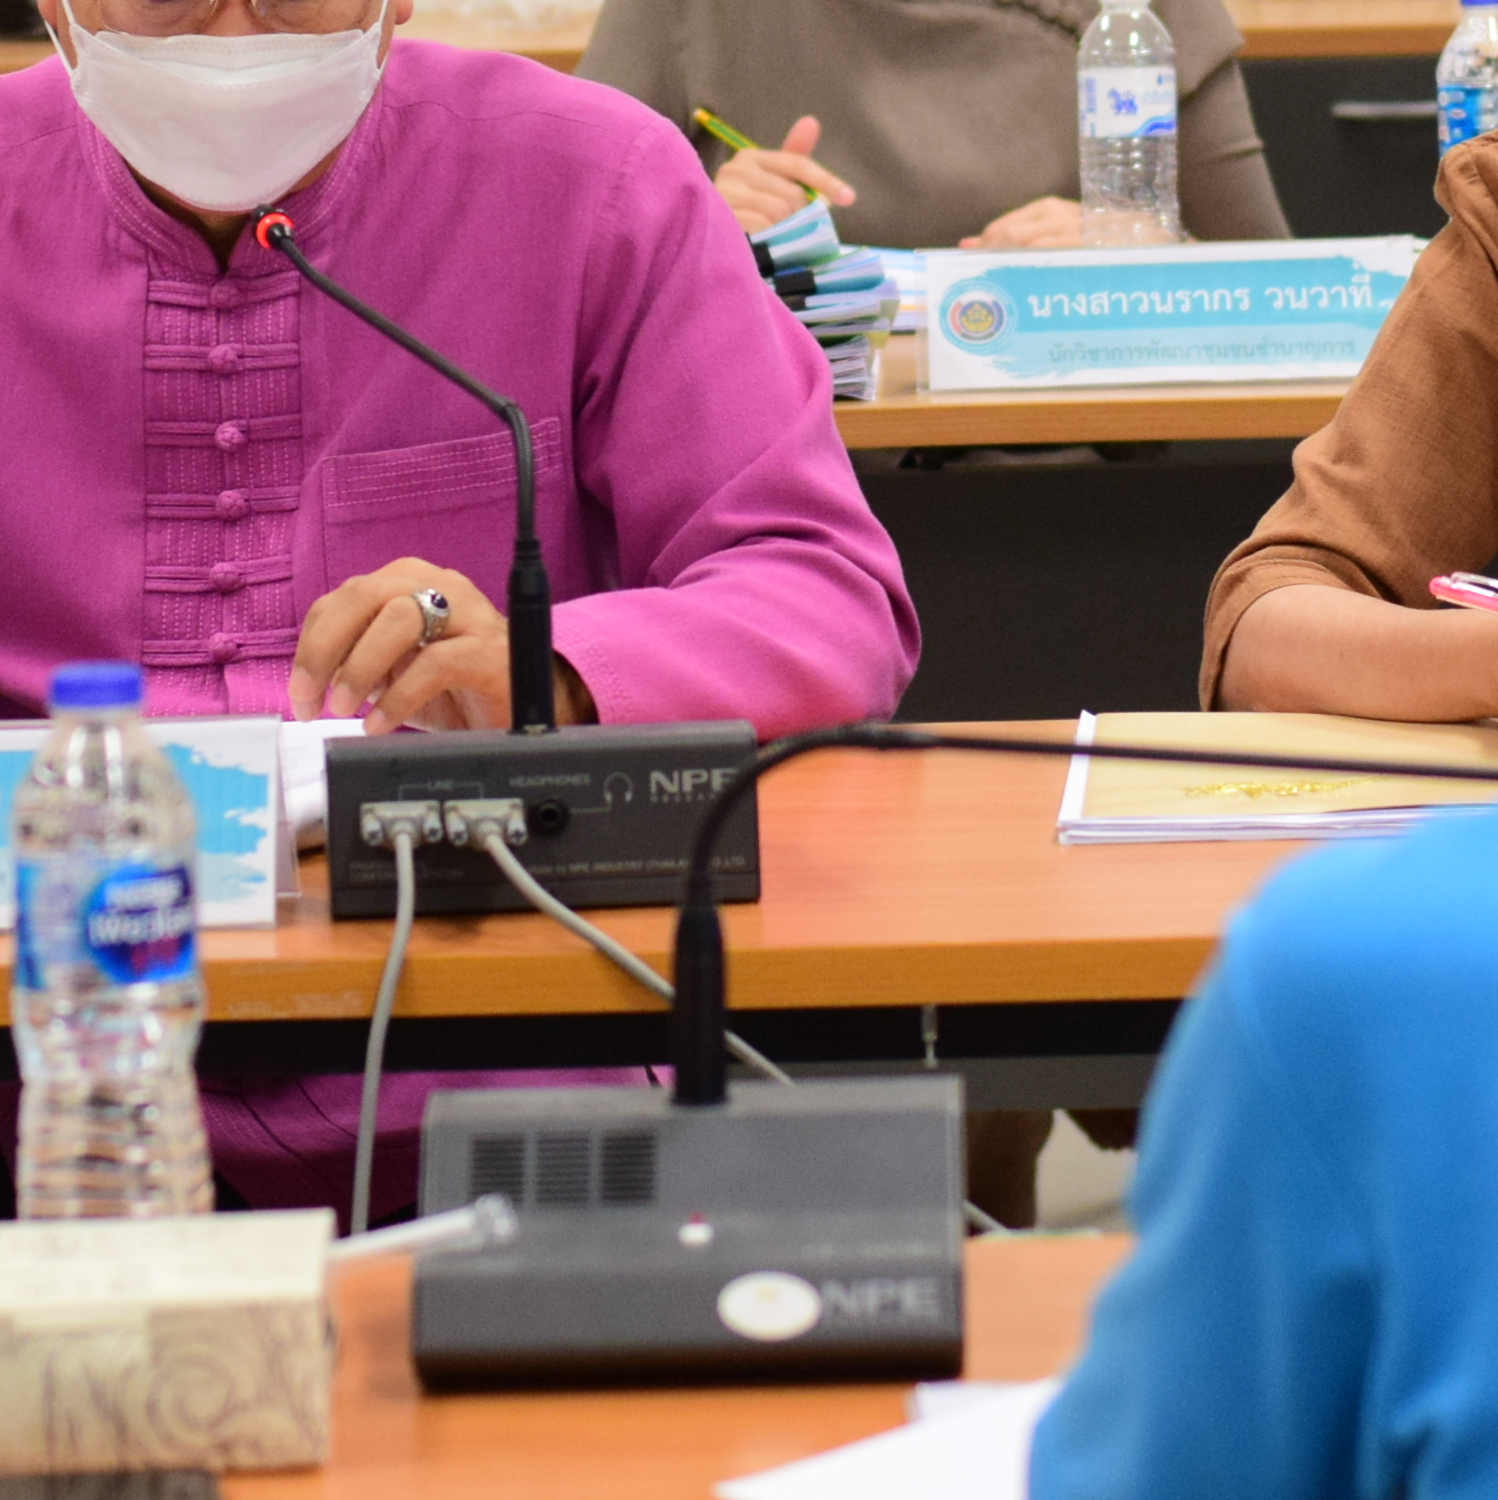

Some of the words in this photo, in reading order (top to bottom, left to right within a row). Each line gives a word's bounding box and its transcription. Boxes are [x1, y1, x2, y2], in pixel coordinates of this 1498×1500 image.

[1027, 285, 1251, 318] นางสาวนรากร
